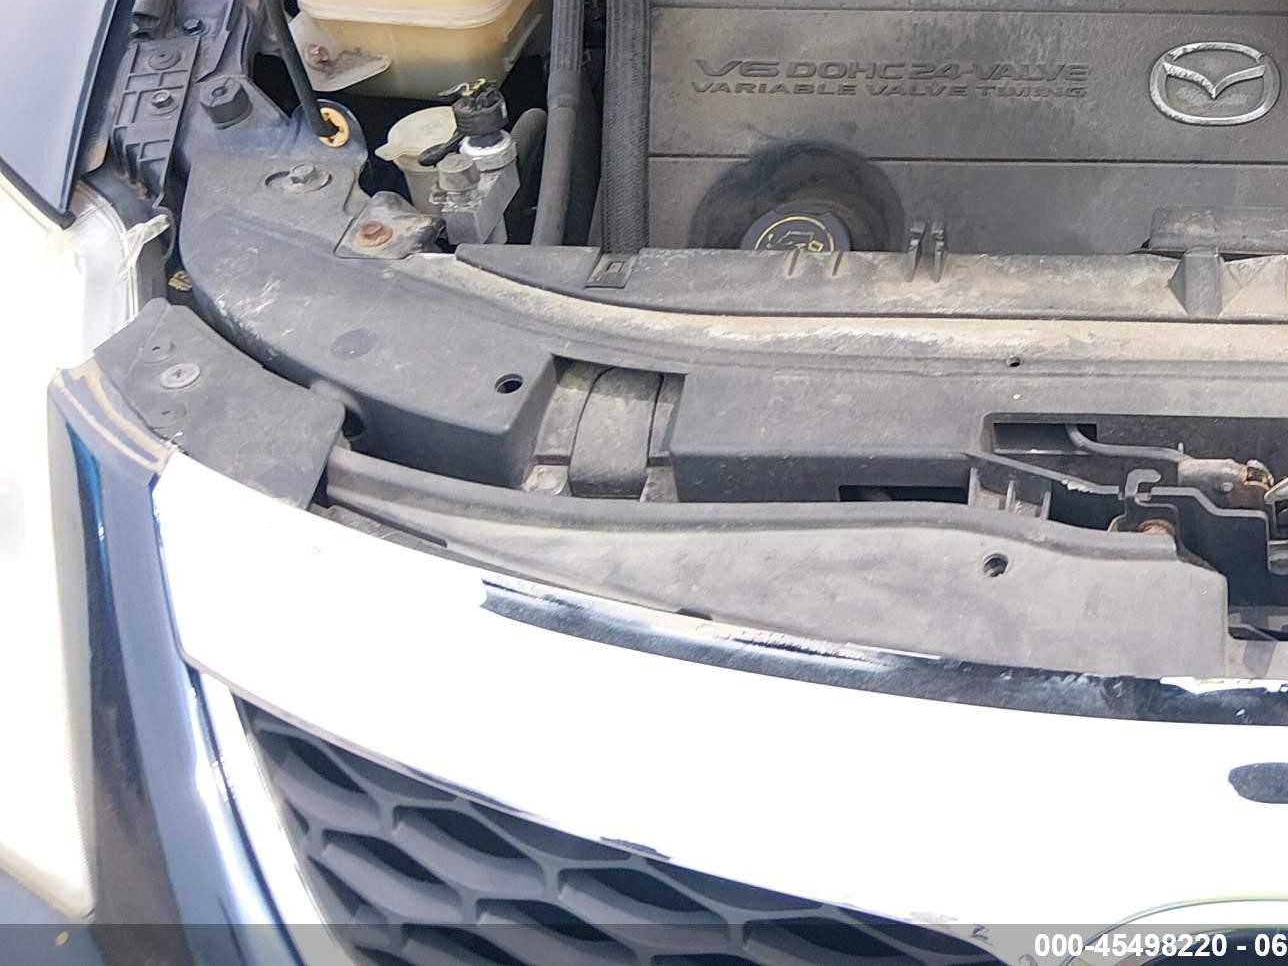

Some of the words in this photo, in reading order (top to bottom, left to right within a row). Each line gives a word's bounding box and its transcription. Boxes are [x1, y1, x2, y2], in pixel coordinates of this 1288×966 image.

[695, 59, 781, 78] V6
[785, 61, 905, 80] DOHC
[907, 63, 1091, 82] 24-VALVE
[691, 81, 857, 96] VARIABLE
[865, 84, 969, 97] VALVE
[976, 85, 1088, 98] TIMING
